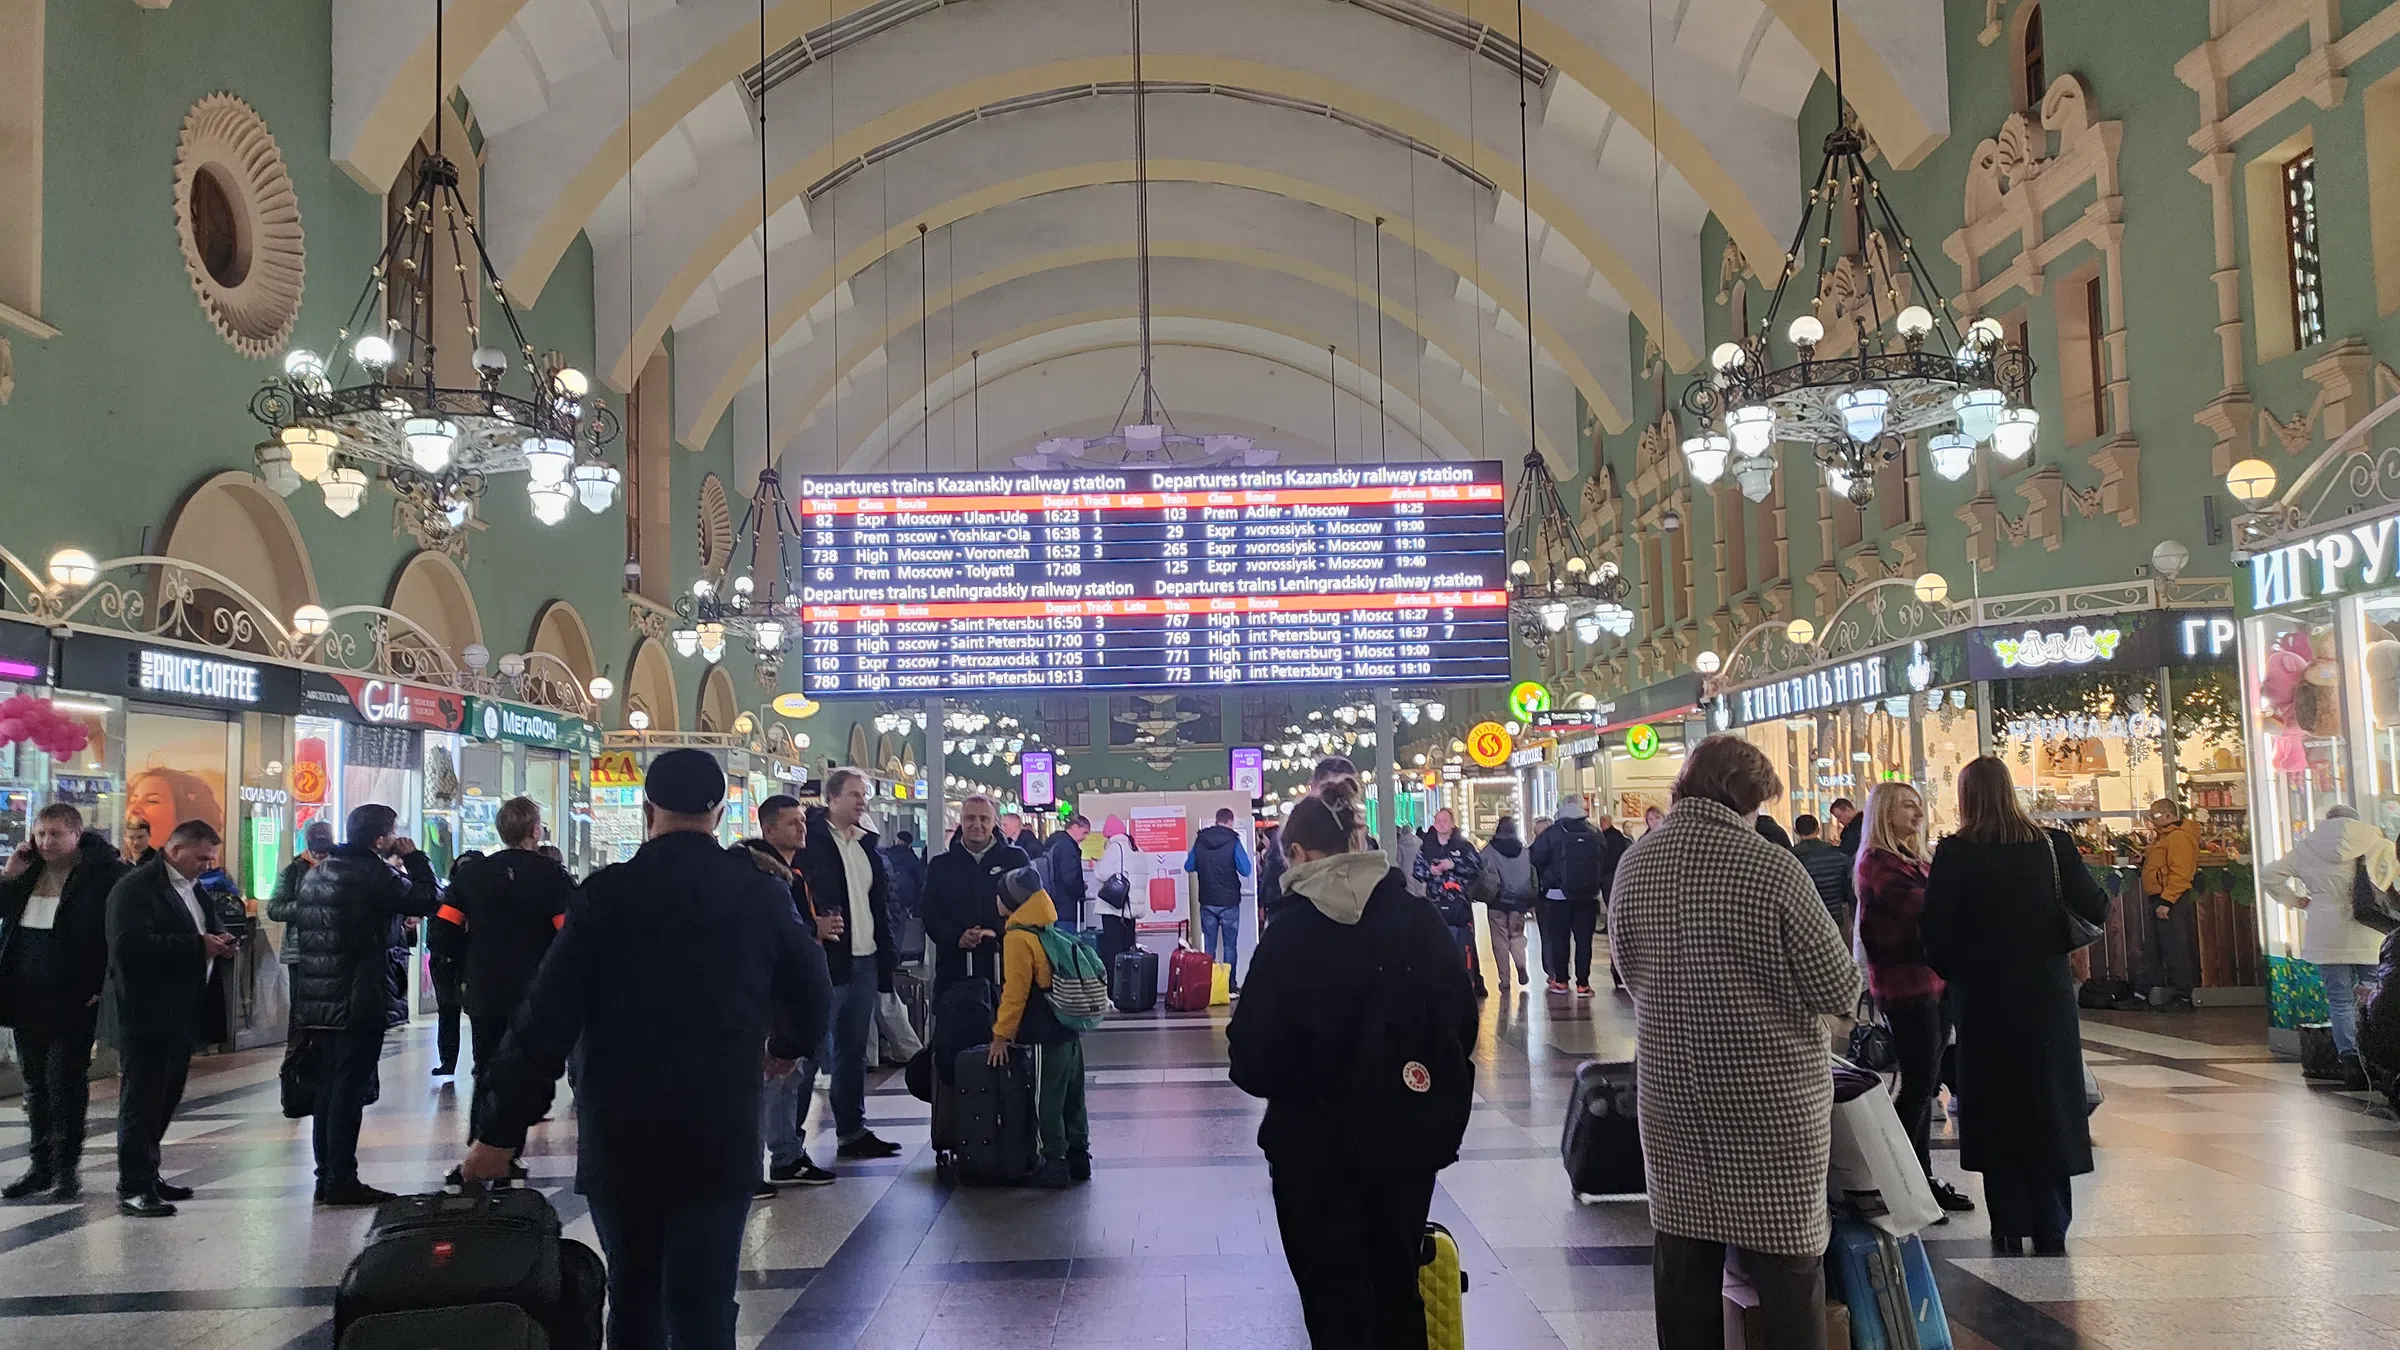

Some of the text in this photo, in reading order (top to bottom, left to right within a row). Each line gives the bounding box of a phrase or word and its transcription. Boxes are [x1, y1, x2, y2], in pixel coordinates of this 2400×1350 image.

[803, 474, 1125, 498] Departures trains Kazanskiy railway station
[1153, 467, 1473, 492] Departures trains Kazanskiy railway station
[816, 515, 833, 527] 82
[857, 514, 886, 529] Expr
[964, 511, 1028, 525] Ulan-Ude
[1044, 510, 1079, 522] 16:23
[1164, 503, 1424, 520] 103 Prem Adler Moscow 18:25
[817, 532, 834, 545] 58
[854, 532, 889, 544] Prem
[949, 529, 1031, 542] Yoshkar-Ola
[1045, 529, 1080, 540] 16:38
[1167, 526, 1184, 538] 29
[1207, 525, 1236, 540] Expr
[1328, 522, 1382, 534] Moscow
[1396, 521, 1424, 532] 19:00
[813, 551, 838, 563] 738
[857, 549, 888, 565] High
[898, 549, 953, 561] Moscow
[965, 547, 1029, 560] Voronezh
[1046, 546, 1081, 558] 16:52
[1164, 544, 1188, 556] 265
[1207, 543, 1237, 557] Expr
[1329, 540, 1383, 552] Moscow
[1397, 538, 1425, 549] 19:10
[817, 564, 1081, 581] 66 Prem Moscow Tolyatti 17:08
[1165, 561, 1188, 574] 125
[1208, 560, 1237, 575] Expr
[1329, 557, 1383, 569] Moscow
[2251, 517, 2400, 610] ИГРУ
[804, 582, 1134, 604] Departures trains Leningradskiy railway station
[1156, 573, 1483, 596] Departures trains Leningradskiy railway station
[814, 622, 838, 634] 776
[857, 621, 889, 636] High
[951, 619, 984, 631] Saint
[988, 618, 1043, 630] Petersbu
[1047, 617, 1082, 629] 16:50
[1165, 614, 1189, 627] 767
[1208, 613, 1239, 629] High
[1271, 611, 1340, 626] Petersburg
[1399, 609, 1428, 620] 16:27
[814, 640, 839, 652] 778
[857, 638, 889, 654] High
[951, 636, 985, 649] Saint
[988, 636, 1044, 648] Petersbu
[1047, 635, 1083, 647] 17:00
[1166, 632, 1189, 645] 769
[1208, 631, 1239, 647] High
[1271, 629, 1341, 644] Petersburg
[1400, 627, 1429, 638] 16:37
[815, 658, 839, 670] 160
[858, 657, 889, 673] Expr
[952, 653, 1039, 667] Petrozavodsk
[1048, 653, 1083, 665] 17:05
[1166, 650, 1189, 663] 771
[1209, 649, 1240, 664] High
[1272, 646, 1342, 661] Petersburg
[1401, 644, 1429, 656] 19:00
[141, 650, 153, 688] ONE
[153, 653, 259, 702] PRICE COFFEE
[1166, 668, 1190, 680] 773
[1209, 666, 1241, 682] High
[1272, 664, 1342, 680] Petersburg
[1401, 663, 1430, 674] 19:10
[814, 676, 839, 689] 780
[857, 675, 890, 691] High
[952, 673, 986, 685] Saint
[989, 671, 1044, 684] Petersbu
[1048, 671, 1083, 683] 19:13
[1742, 656, 1882, 722] ХИНКАЛЬНАЯ
[590, 757, 638, 782] КА
